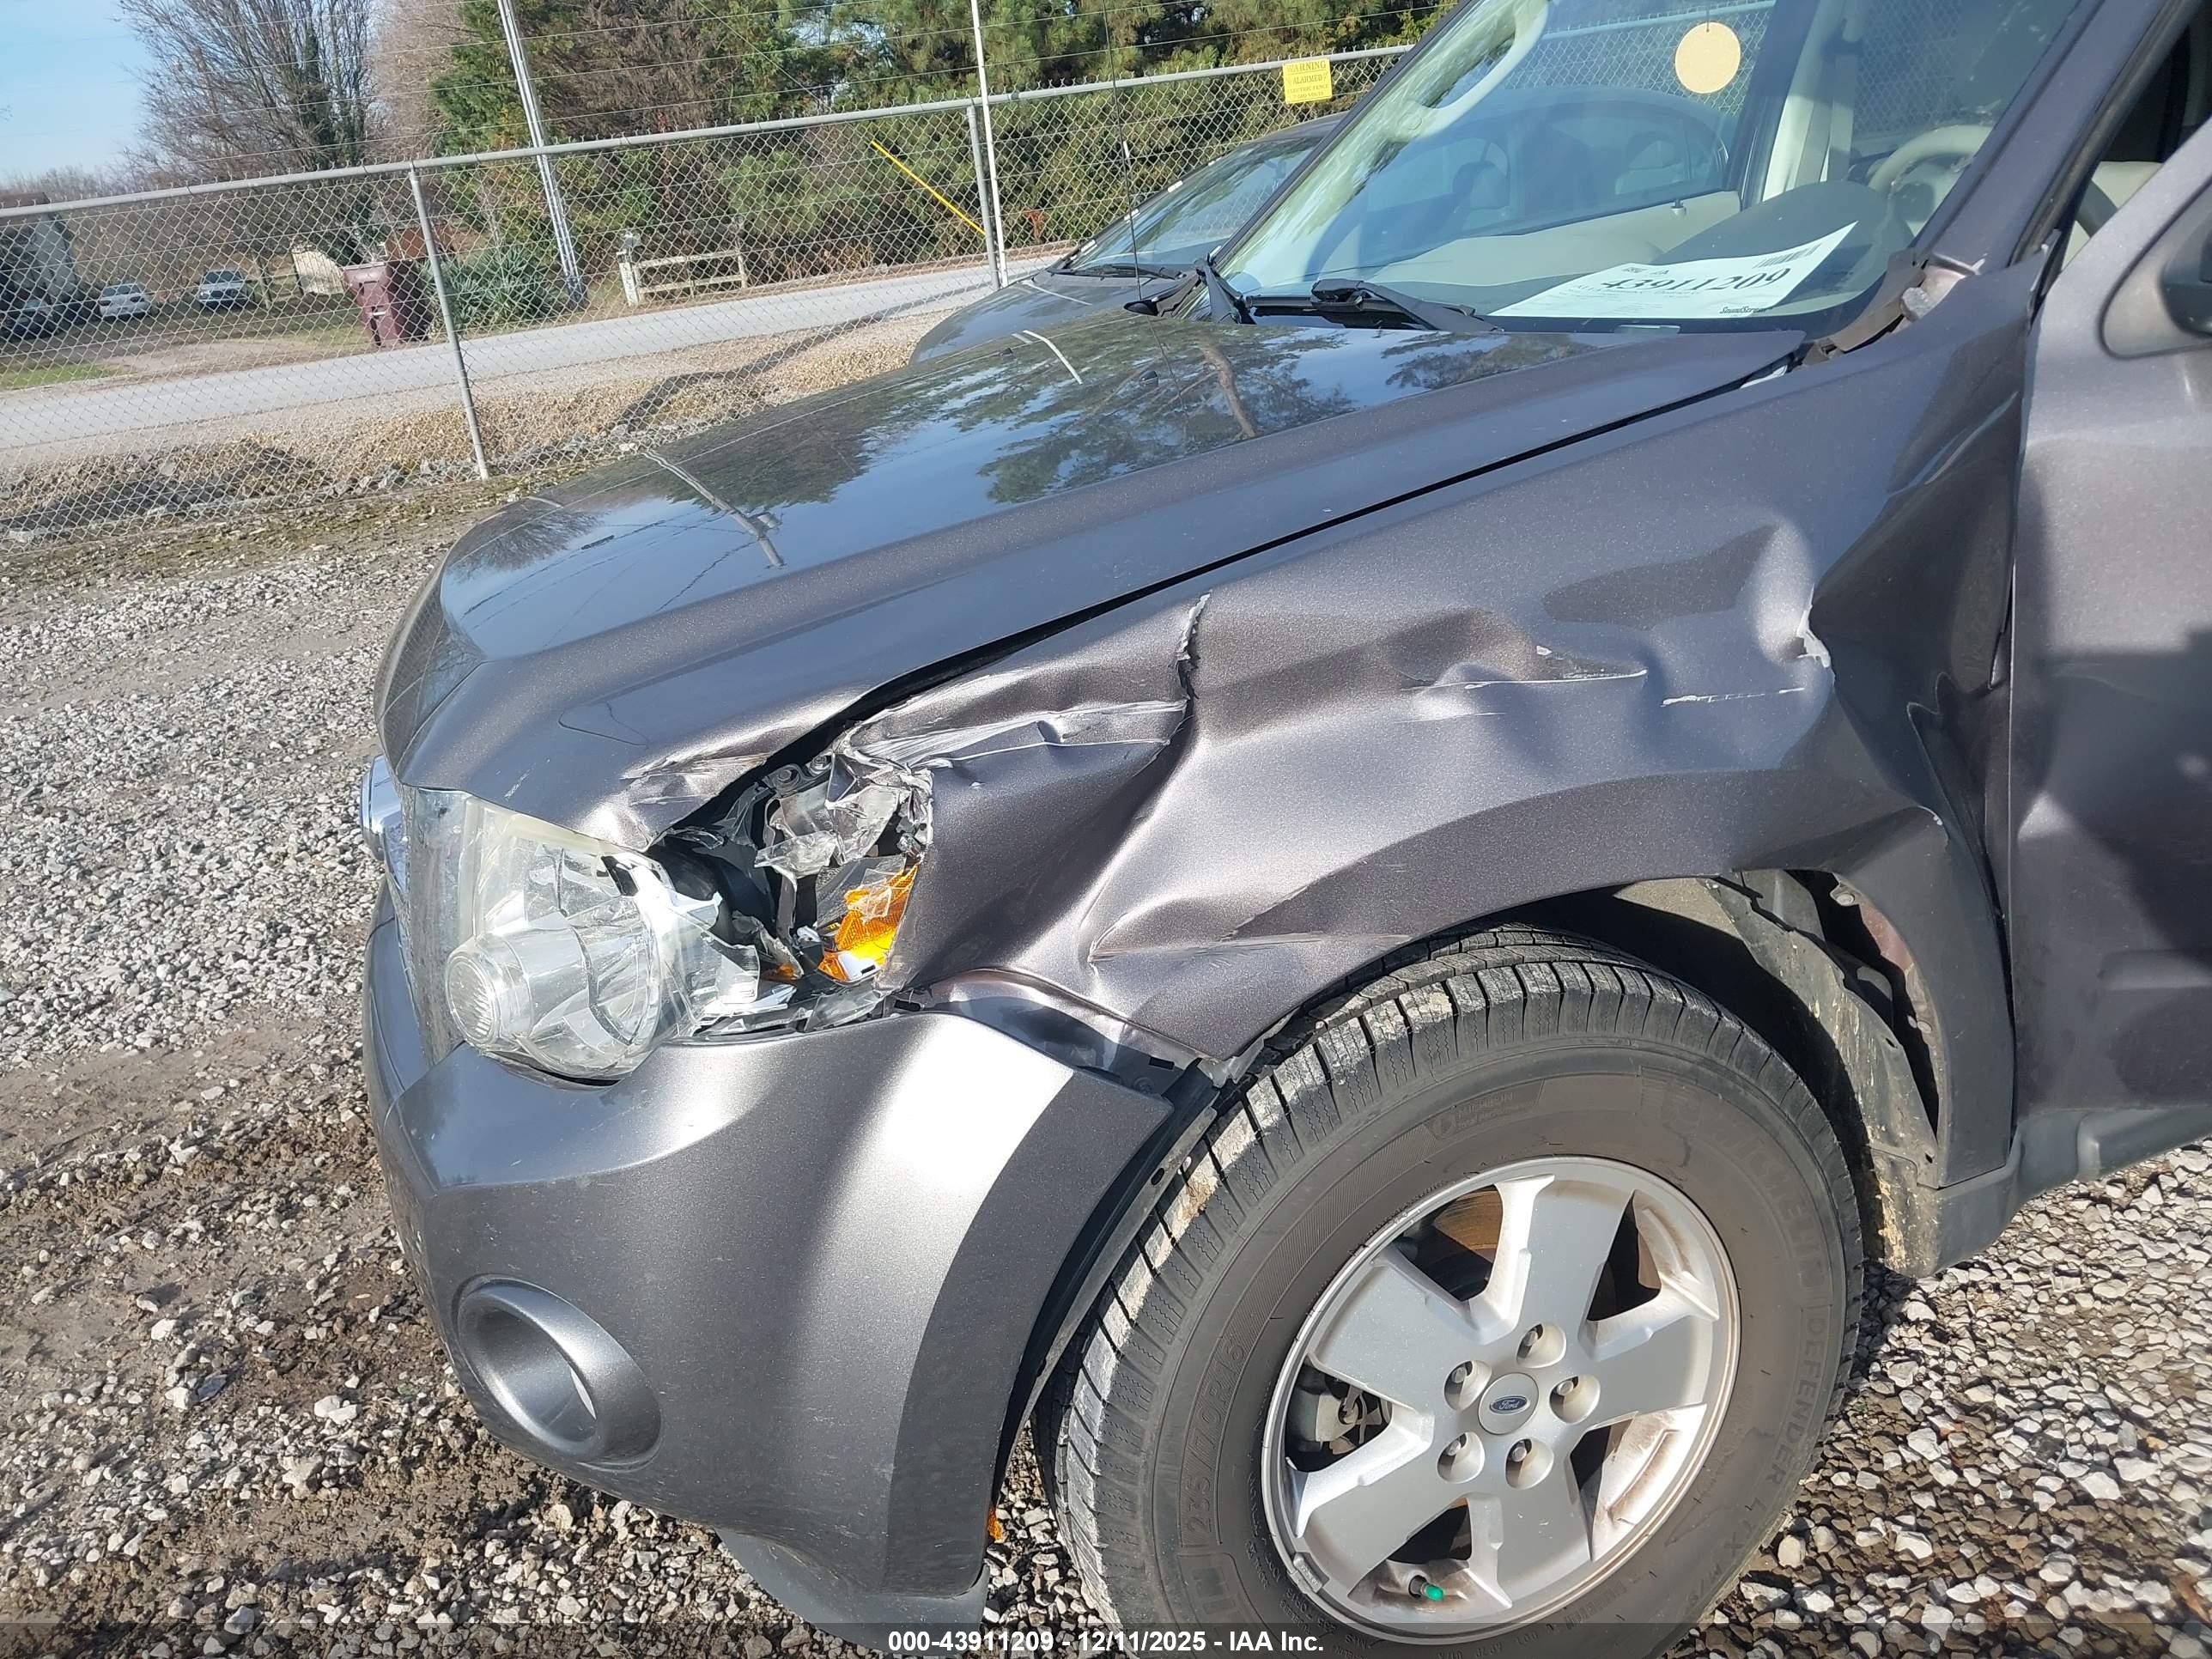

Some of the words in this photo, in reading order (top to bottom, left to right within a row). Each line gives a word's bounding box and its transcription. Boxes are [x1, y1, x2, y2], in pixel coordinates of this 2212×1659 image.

[1287, 61, 1326, 72] WARNING
[1293, 75, 1322, 84] ALARMED
[1601, 268, 1790, 290] 43911209
[1499, 1399, 1520, 1410] Ford
[1765, 1317, 1826, 1486] DEFENDER
